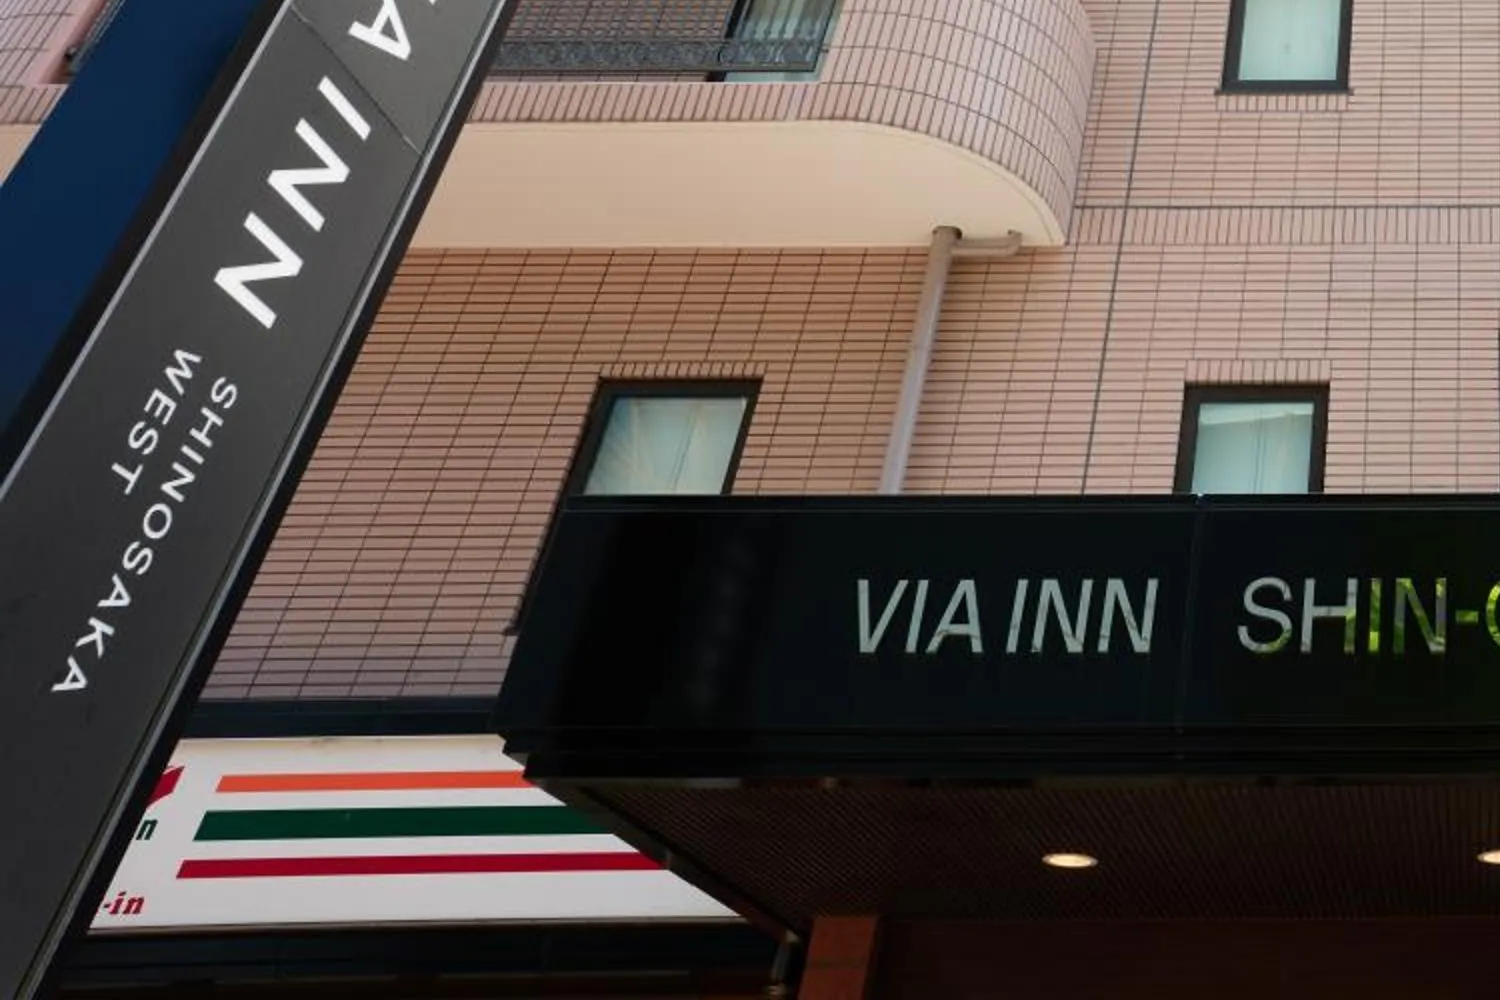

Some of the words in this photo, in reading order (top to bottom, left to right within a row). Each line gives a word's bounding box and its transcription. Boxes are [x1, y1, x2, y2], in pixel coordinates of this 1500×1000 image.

[214, 76, 371, 330] INN
[111, 348, 203, 495] WEST
[51, 376, 239, 692] SHINOSAKA
[857, 578, 984, 654] VIA
[1005, 577, 1159, 654] INN
